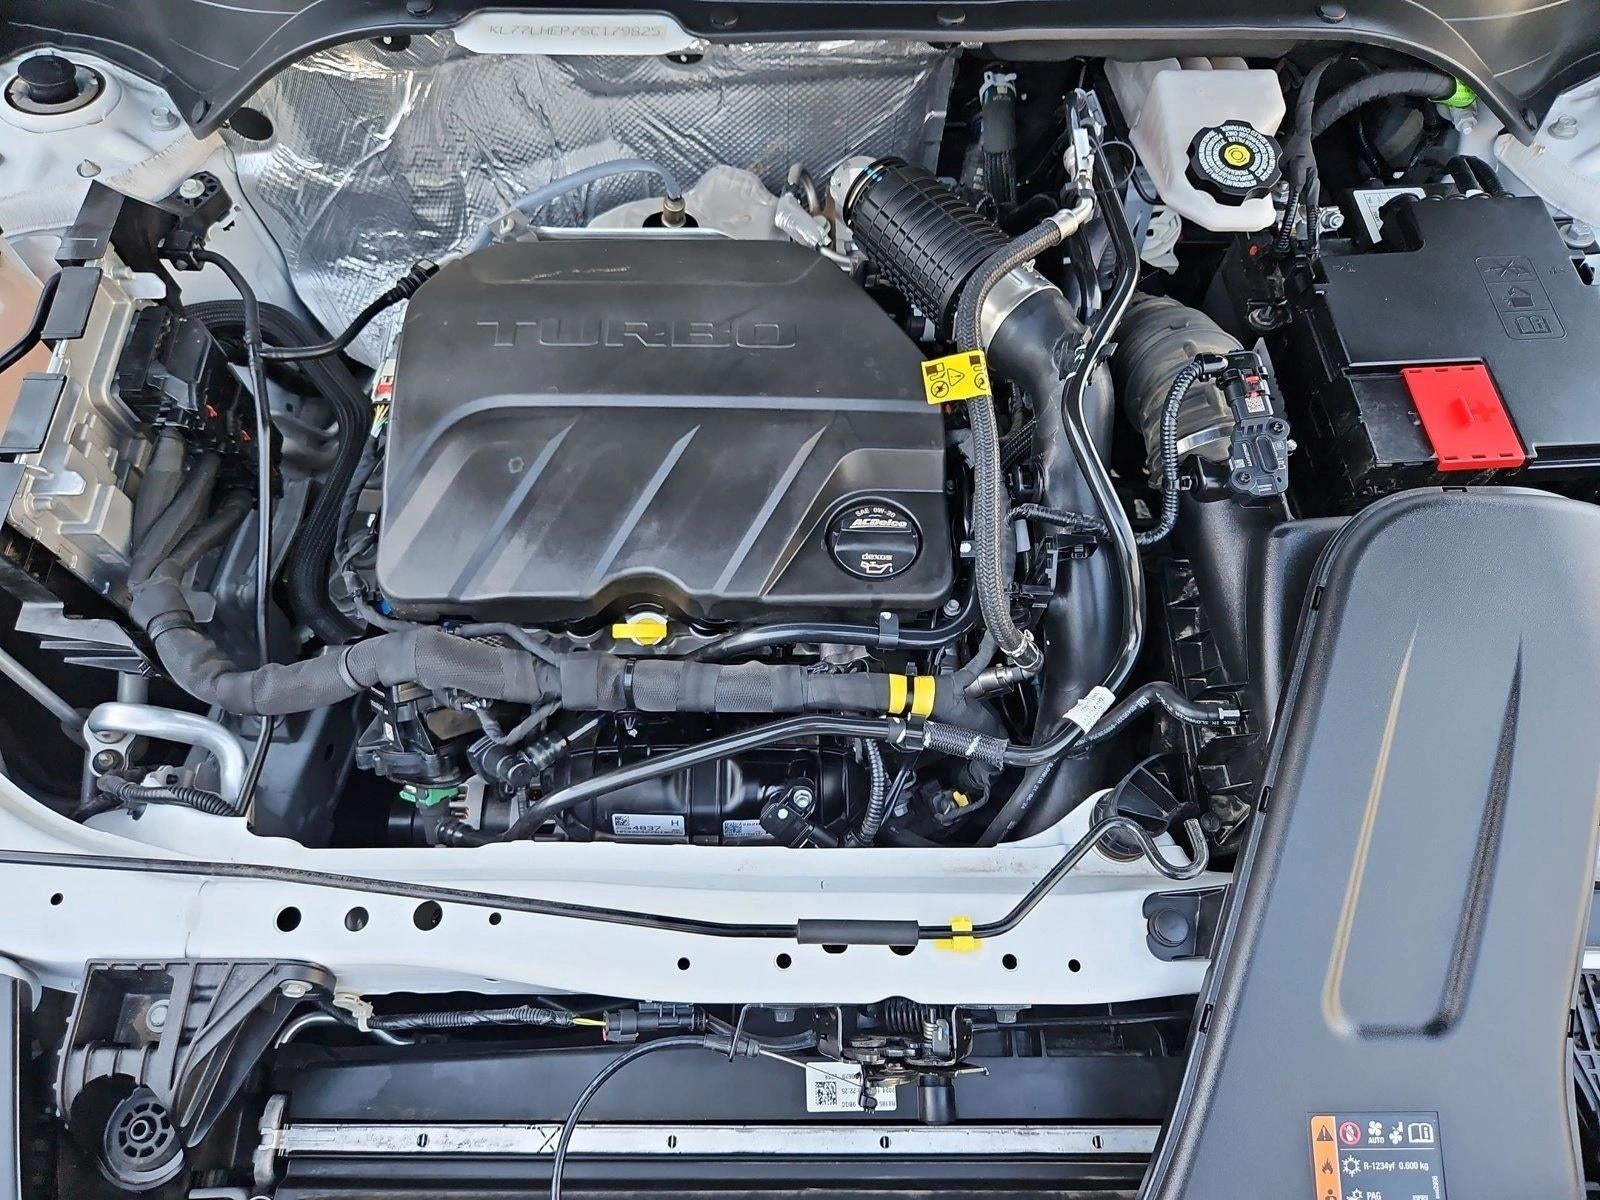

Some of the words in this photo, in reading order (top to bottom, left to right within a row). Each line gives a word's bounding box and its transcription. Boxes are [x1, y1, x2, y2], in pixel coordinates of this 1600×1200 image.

[476, 320, 797, 348] TURBO
[855, 508, 870, 517] SAE
[849, 518, 907, 528] ACDelco
[862, 552, 893, 560] dexos
[1364, 1162, 1395, 1171] R-1234yf
[1398, 1162, 1418, 1170] 0.600
[1419, 1162, 1429, 1172] kg
[1367, 1192, 1382, 1200] PAG
